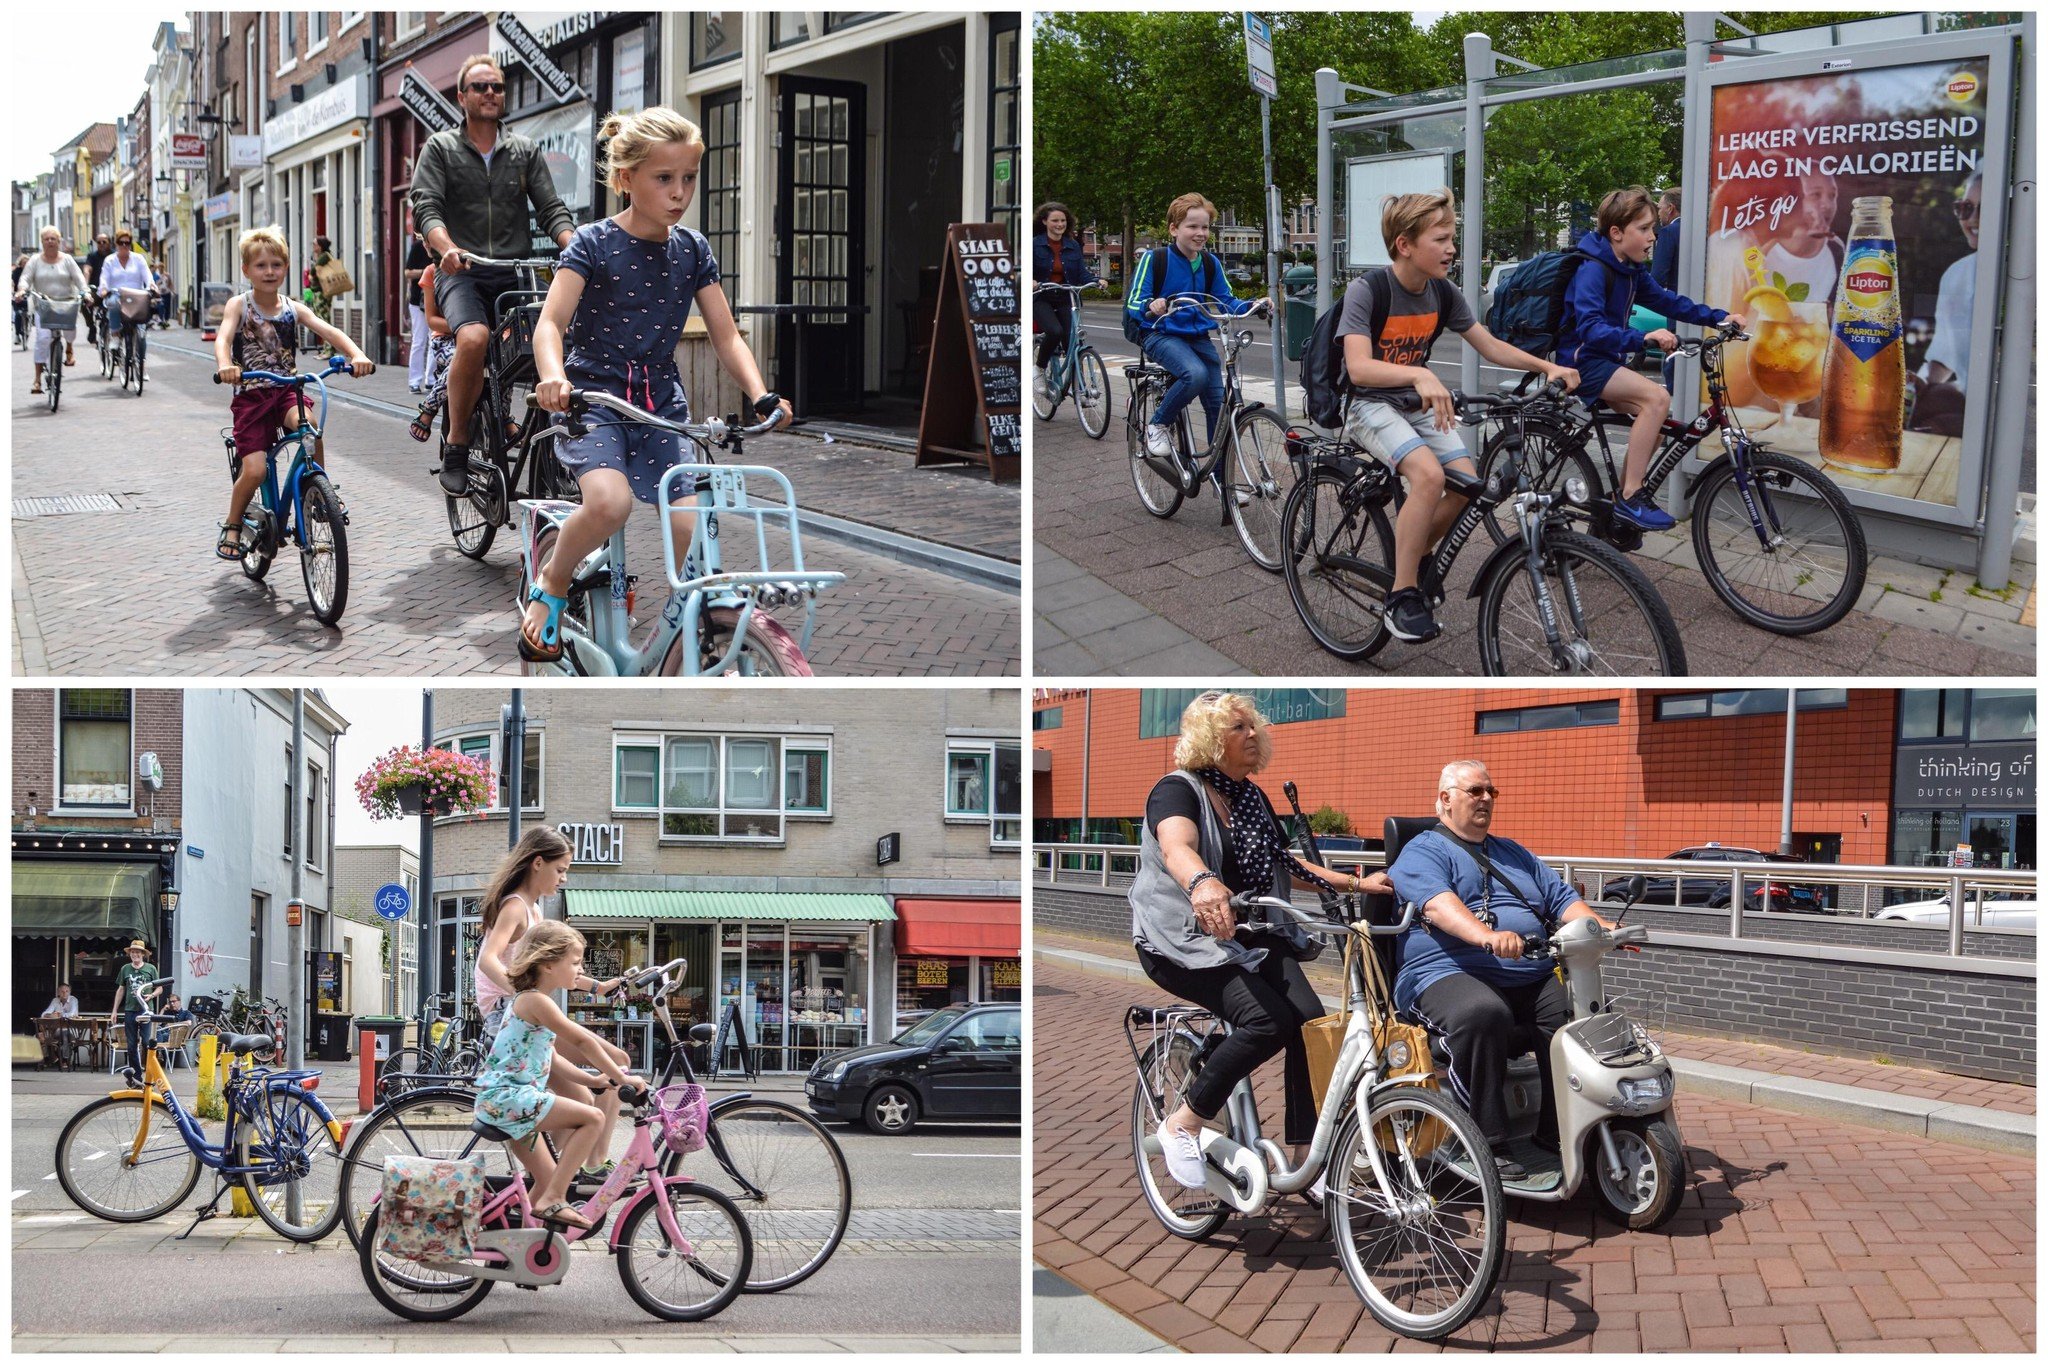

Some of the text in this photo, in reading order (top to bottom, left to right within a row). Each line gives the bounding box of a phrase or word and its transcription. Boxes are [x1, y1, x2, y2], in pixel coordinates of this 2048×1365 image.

[535, 12, 596, 49] ECIALIST
[499, 11, 571, 93] Schoenreparatie
[1951, 82, 1974, 93] Lipton
[401, 76, 456, 131] Sleutelserv
[1719, 116, 1978, 152] LEKKER VERFRISSEND
[1718, 144, 1977, 180] LAAG IN CALORIEËN
[1720, 194, 1799, 240] Let's go
[1849, 276, 1889, 290] Lipton
[1843, 327, 1890, 338] SPARKLING
[1866, 336, 1881, 344] TEA
[1383, 346, 1424, 366] Klein
[1919, 754, 2033, 782] thinking of
[1918, 788, 1962, 797] DUTCH
[1971, 787, 2024, 798] DESIGN
[2000, 819, 2011, 827] 23
[917, 960, 949, 971] KAAS
[917, 970, 948, 978] BOTER
